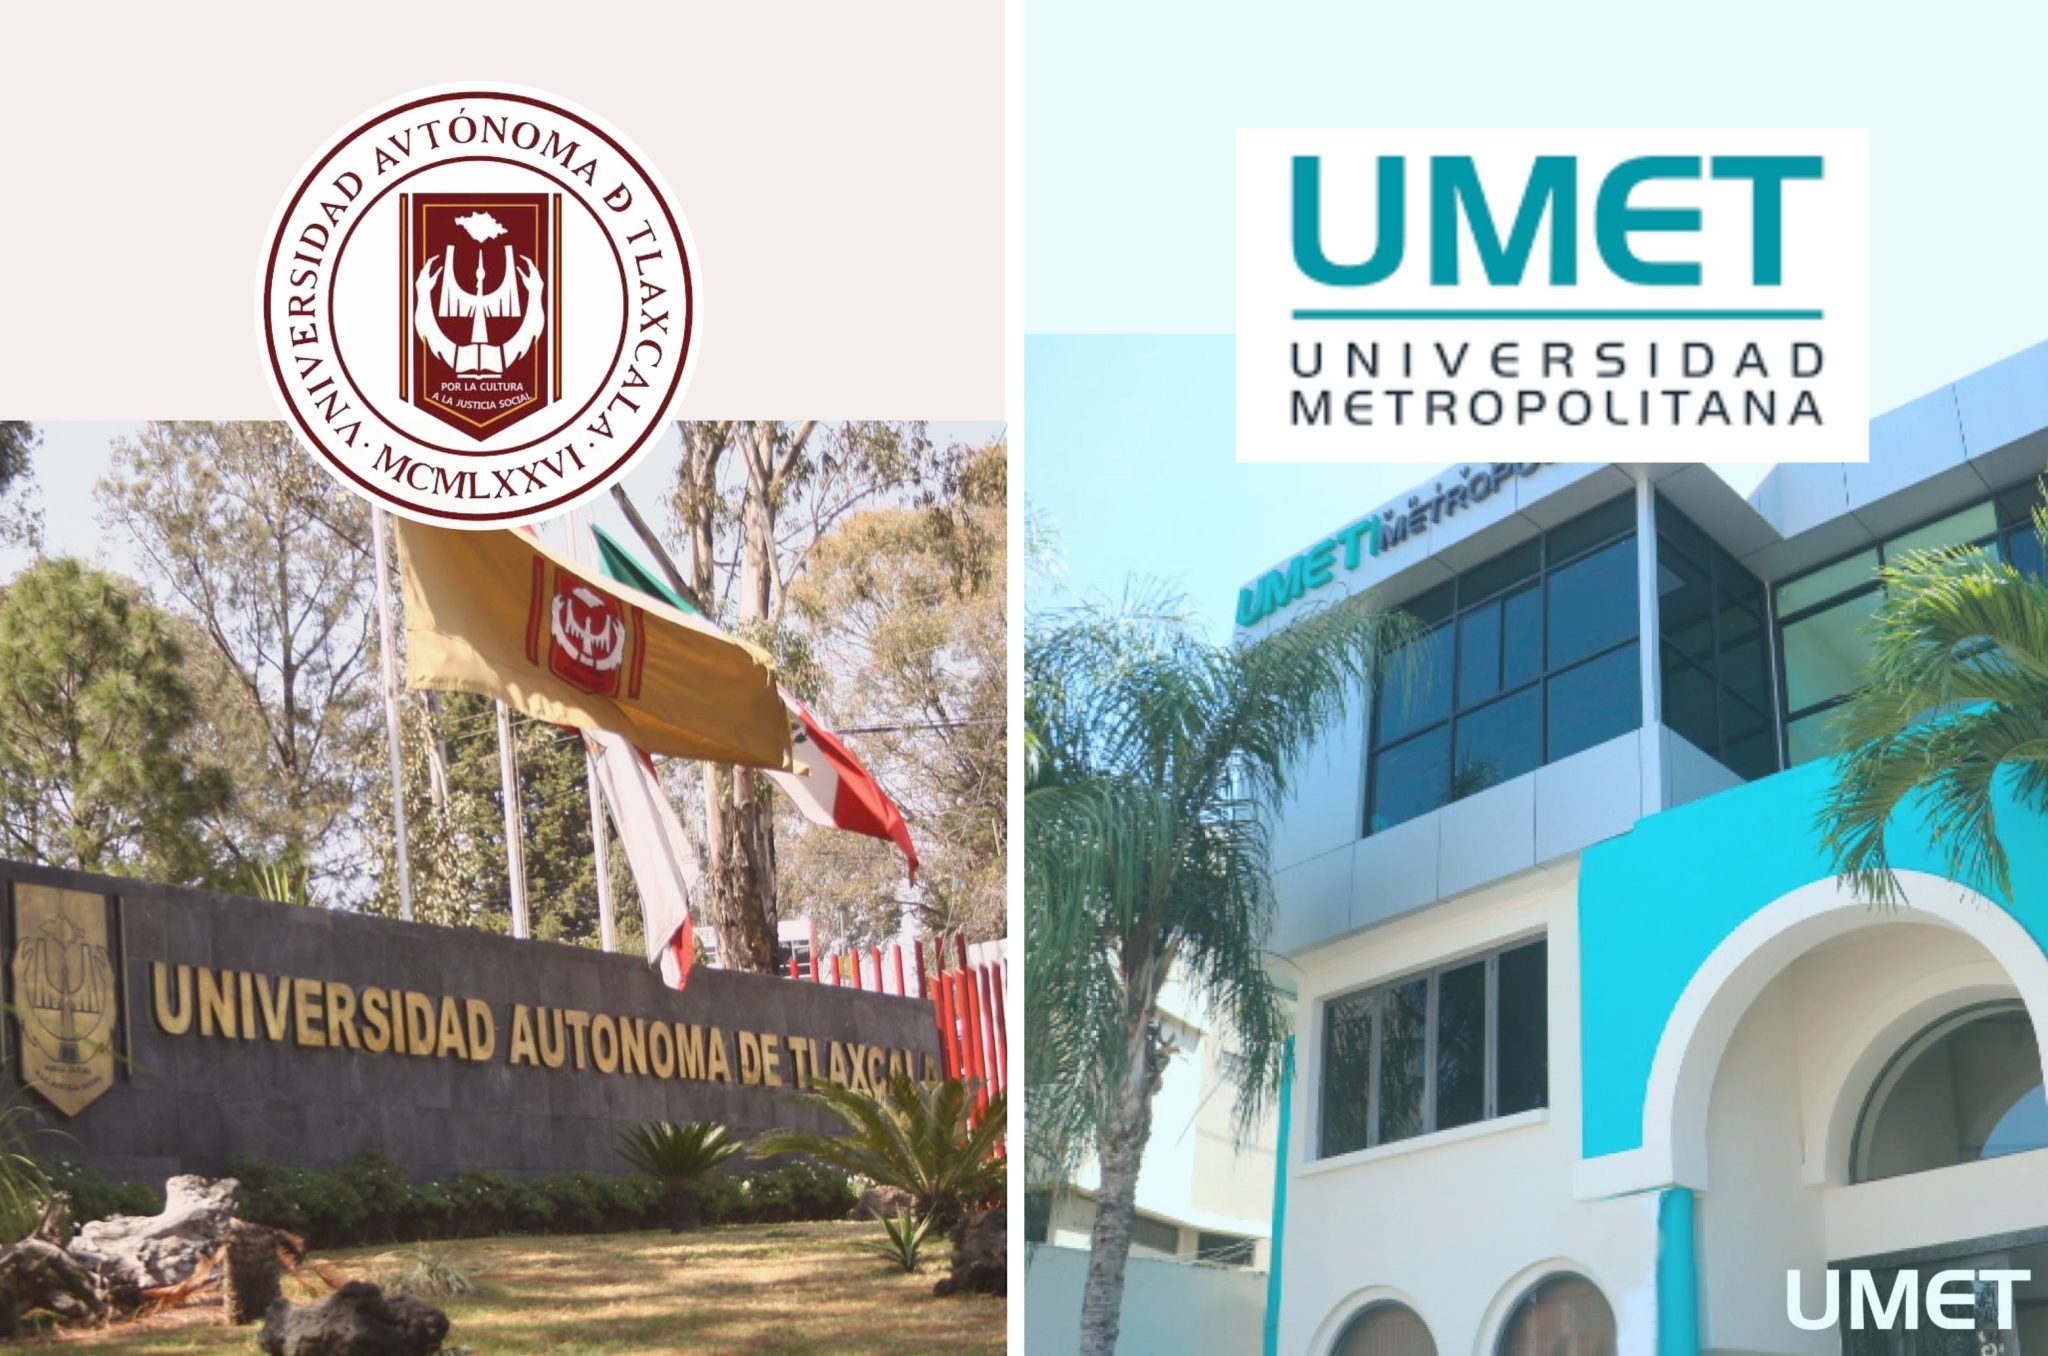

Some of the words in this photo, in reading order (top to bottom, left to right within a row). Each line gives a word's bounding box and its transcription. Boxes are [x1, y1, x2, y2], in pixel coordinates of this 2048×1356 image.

[152, 961, 496, 1062] UNIVERSIDAD
[509, 1003, 733, 1084] AUTONOMA
[737, 1030, 783, 1088] DE
